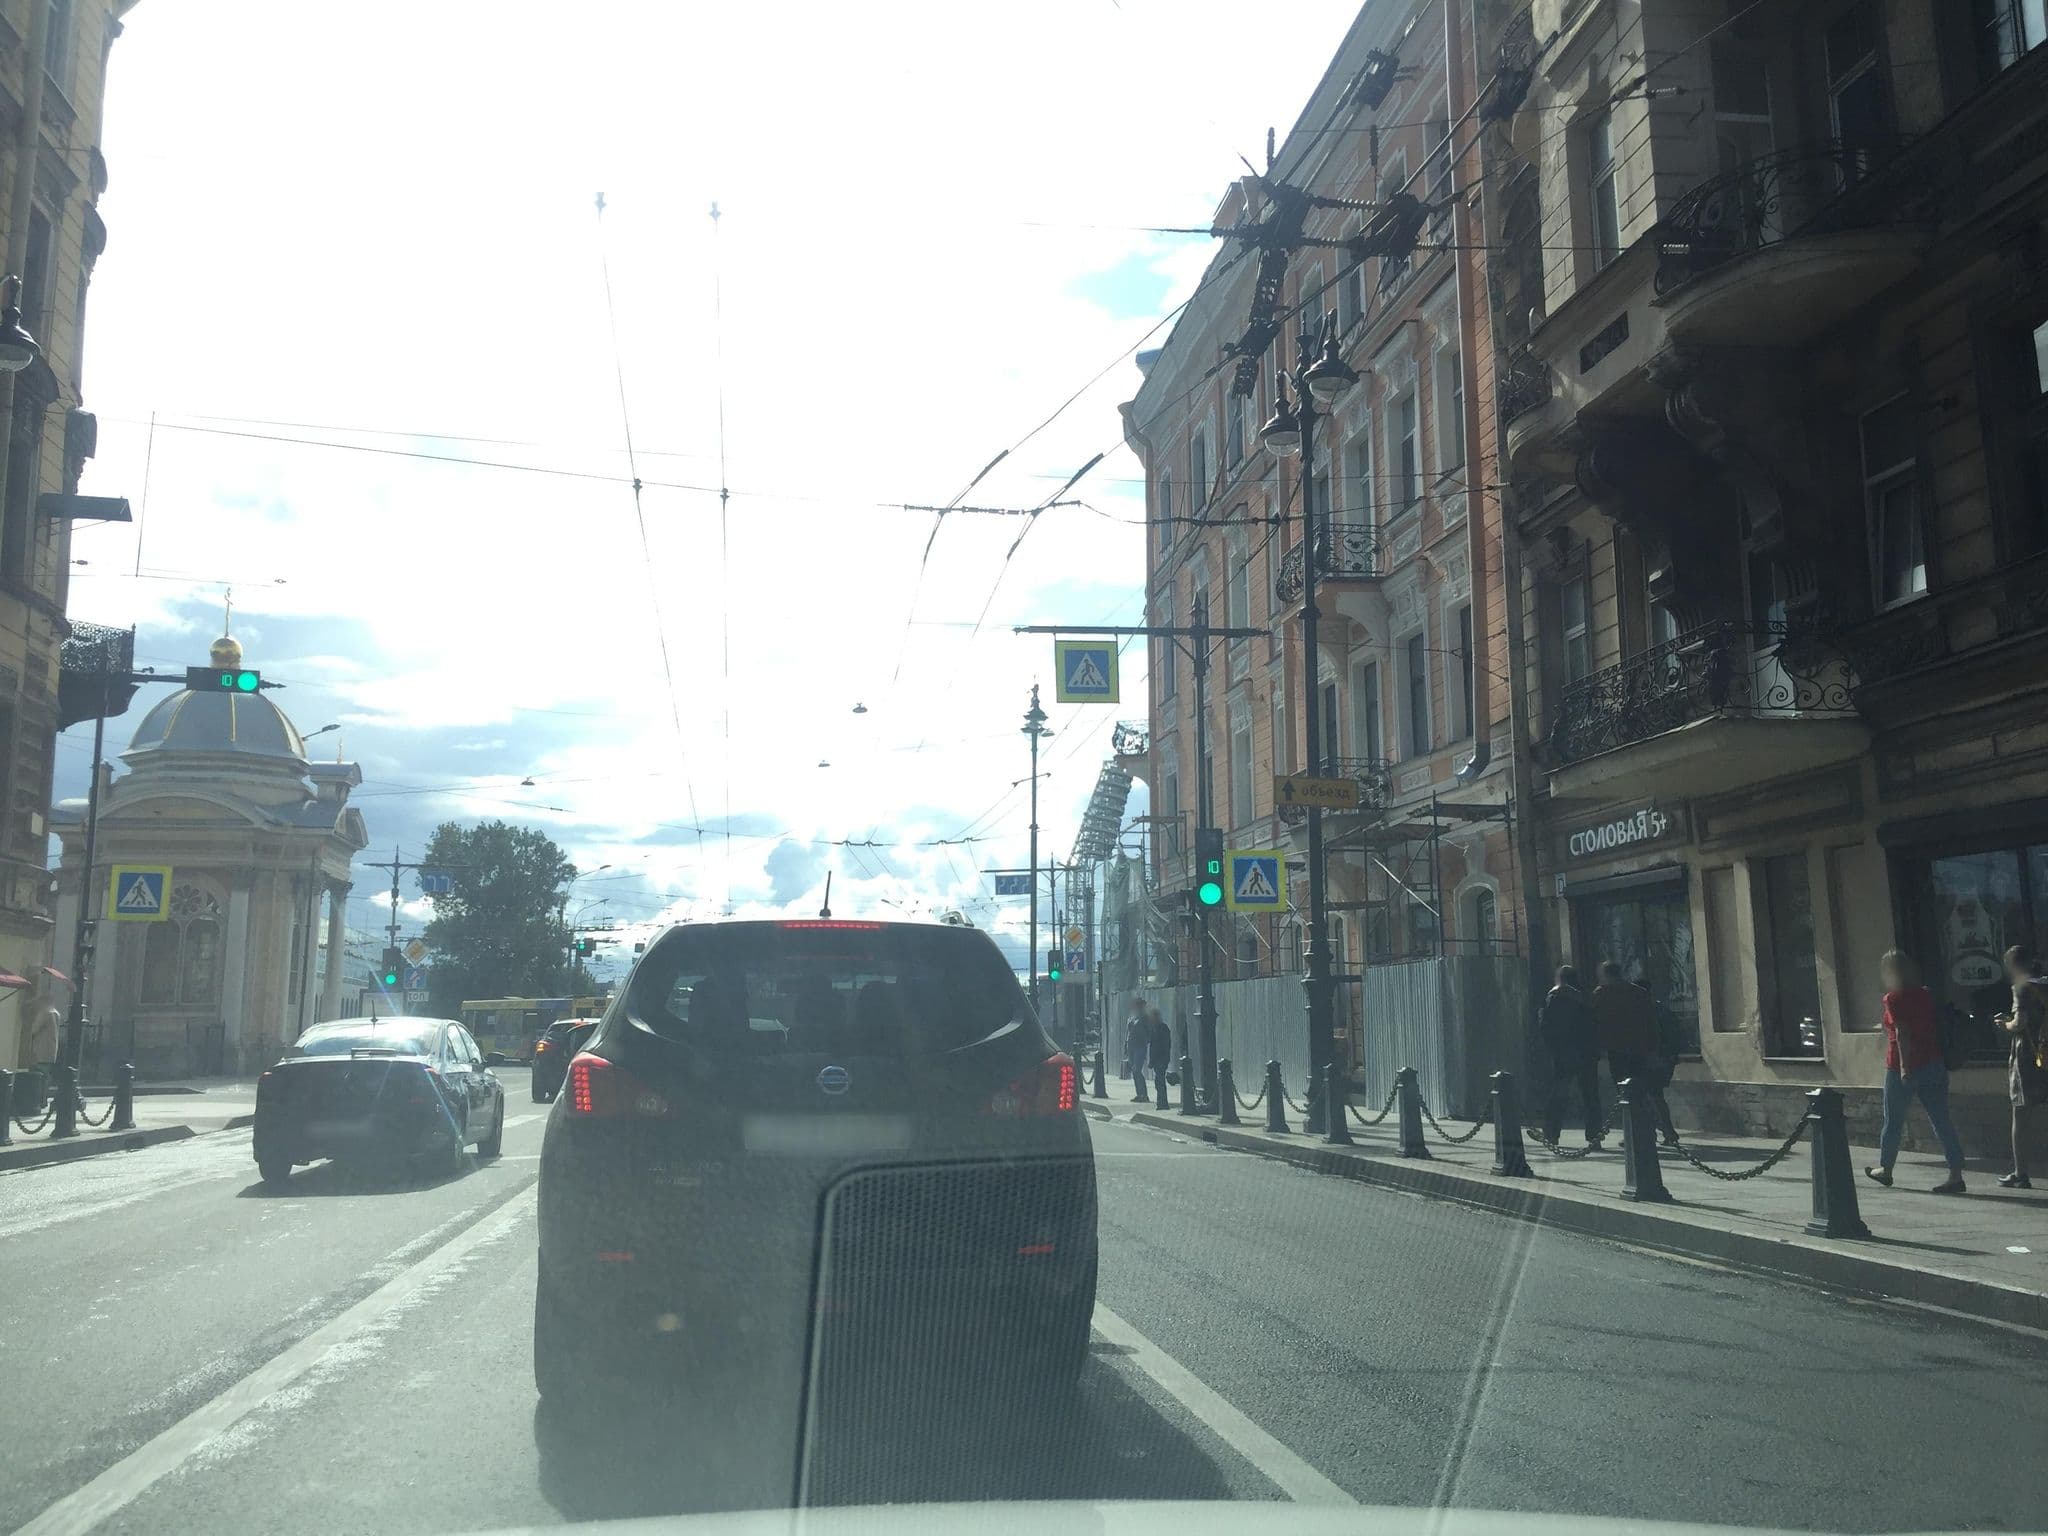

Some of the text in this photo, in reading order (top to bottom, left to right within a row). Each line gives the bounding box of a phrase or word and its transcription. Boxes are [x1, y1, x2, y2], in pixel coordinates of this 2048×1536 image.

[222, 674, 232, 687] 10
[1302, 784, 1350, 800] объезд
[1570, 811, 1648, 856] СТОЛОВАЯ
[1208, 860, 1219, 874] 10
